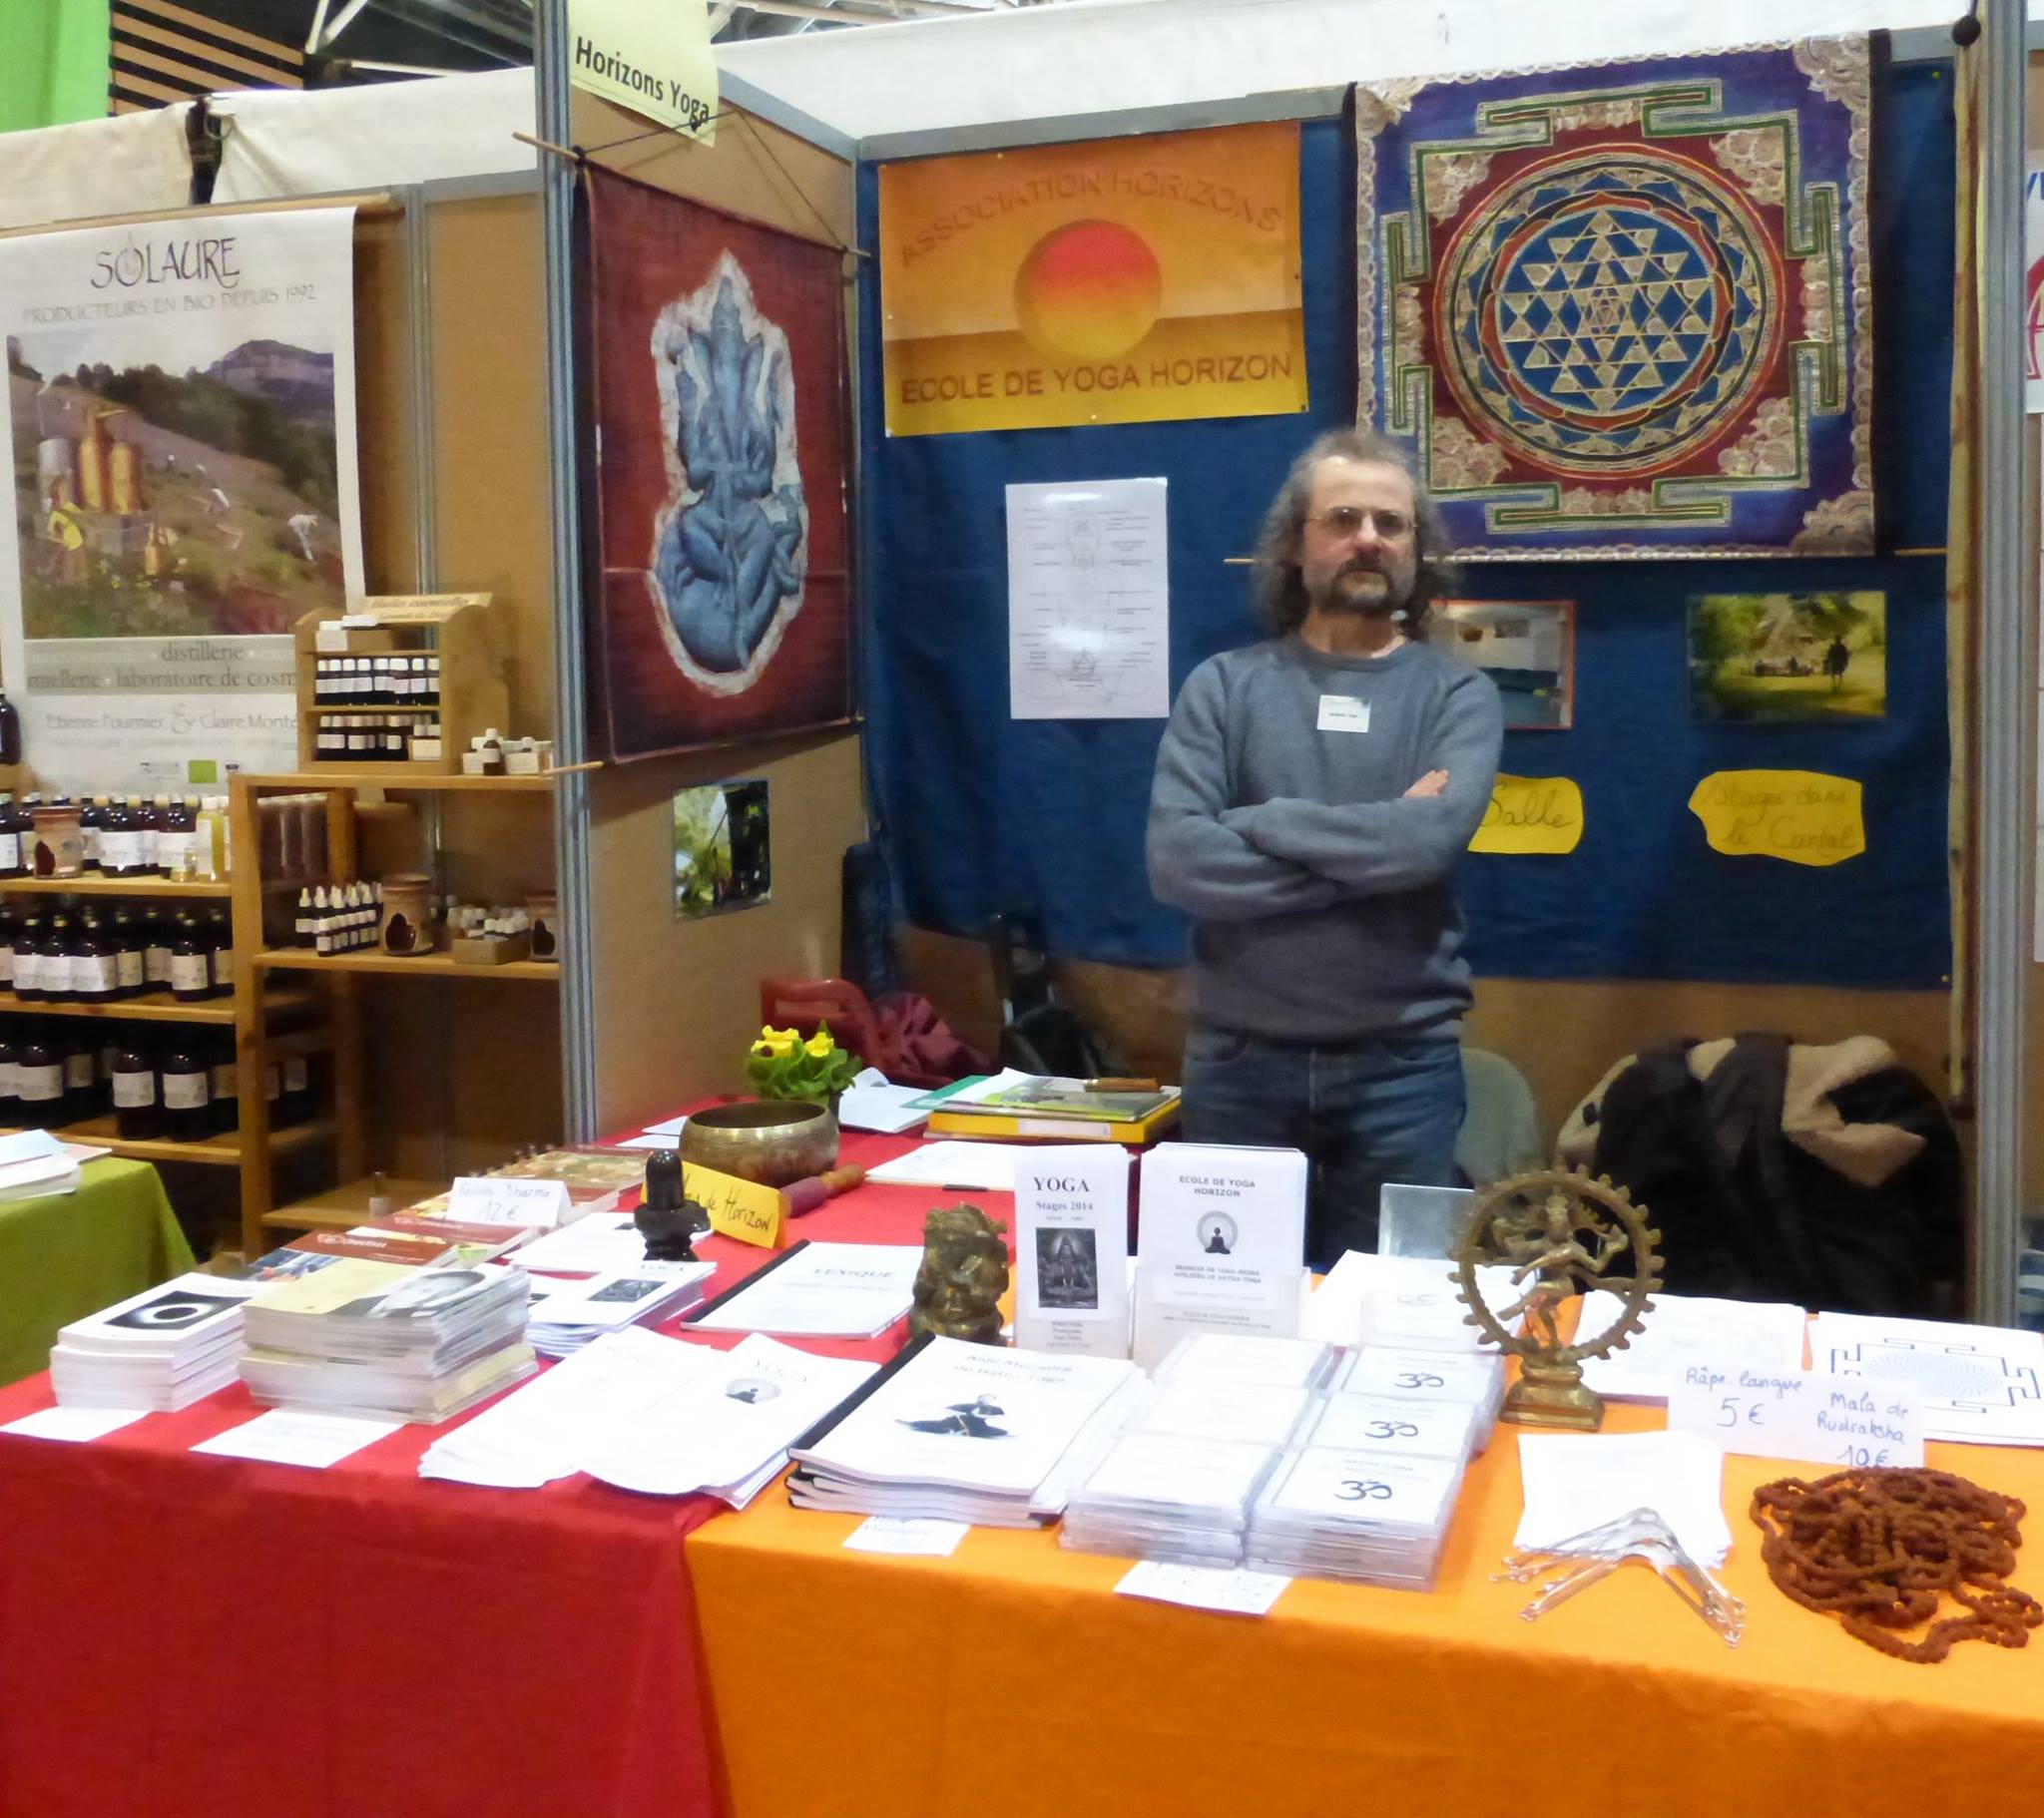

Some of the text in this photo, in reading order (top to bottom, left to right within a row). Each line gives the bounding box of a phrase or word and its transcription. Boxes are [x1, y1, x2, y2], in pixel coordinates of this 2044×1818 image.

[576, 36, 710, 126] Horizons Yoga
[902, 171, 1281, 267] ASSOCIATION HORIZONS
[91, 236, 241, 288] SOLAURE
[22, 283, 317, 324] PRODUCTEURS EN BIO DEPUIS 1992
[902, 354, 1291, 404] ECOLE DE YOGA HORIZON
[161, 642, 244, 661] distillerie
[29, 670, 99, 688] miellerie
[117, 668, 214, 687] laboratoire
[221, 668, 241, 686] de
[201, 709, 243, 729] Claire
[1033, 1176, 1089, 1192] YOGA
[1179, 1174, 1256, 1188] ECOLE DE YOGA
[1194, 1187, 1241, 1197] HORIZON
[1036, 1200, 1093, 1211] Stages 2014
[1829, 1391, 1909, 1419] Mala de
[1816, 1410, 1905, 1445] Rudraksha
